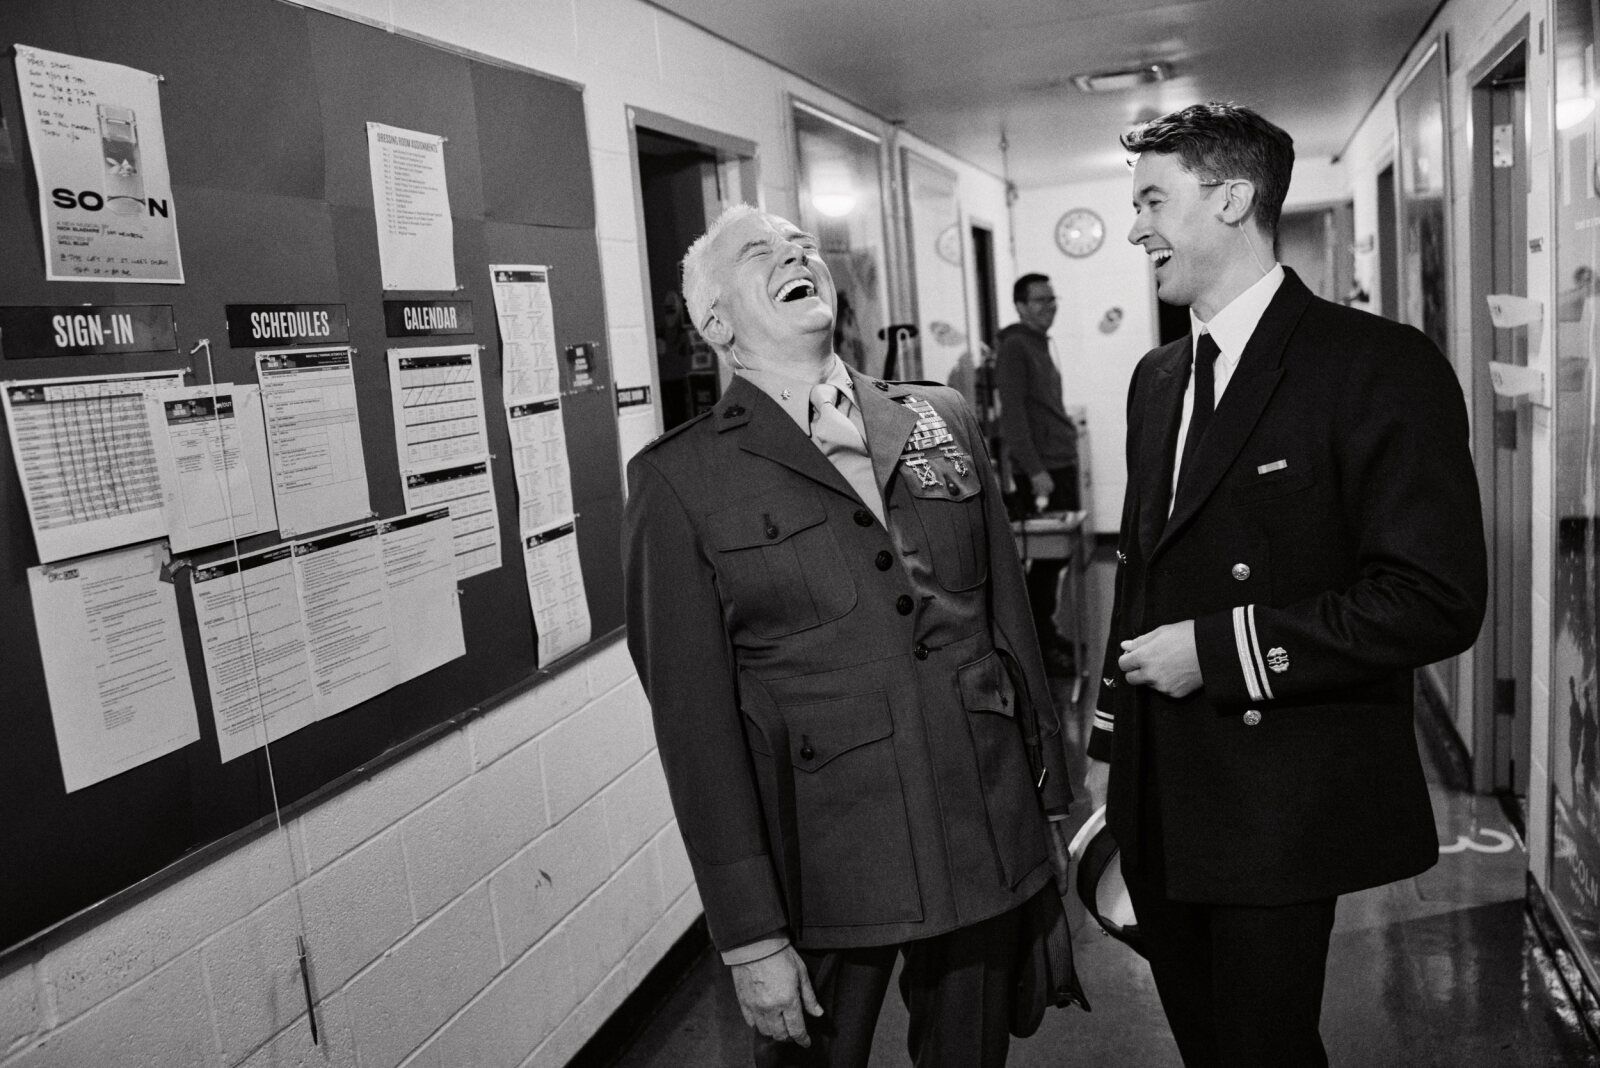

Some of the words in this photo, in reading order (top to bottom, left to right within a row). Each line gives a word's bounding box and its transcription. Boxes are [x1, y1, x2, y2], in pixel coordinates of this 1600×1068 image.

[52, 314, 134, 348] SIGN-IN
[250, 311, 330, 339] SCHEDULES
[403, 306, 458, 330] CALENDAR
